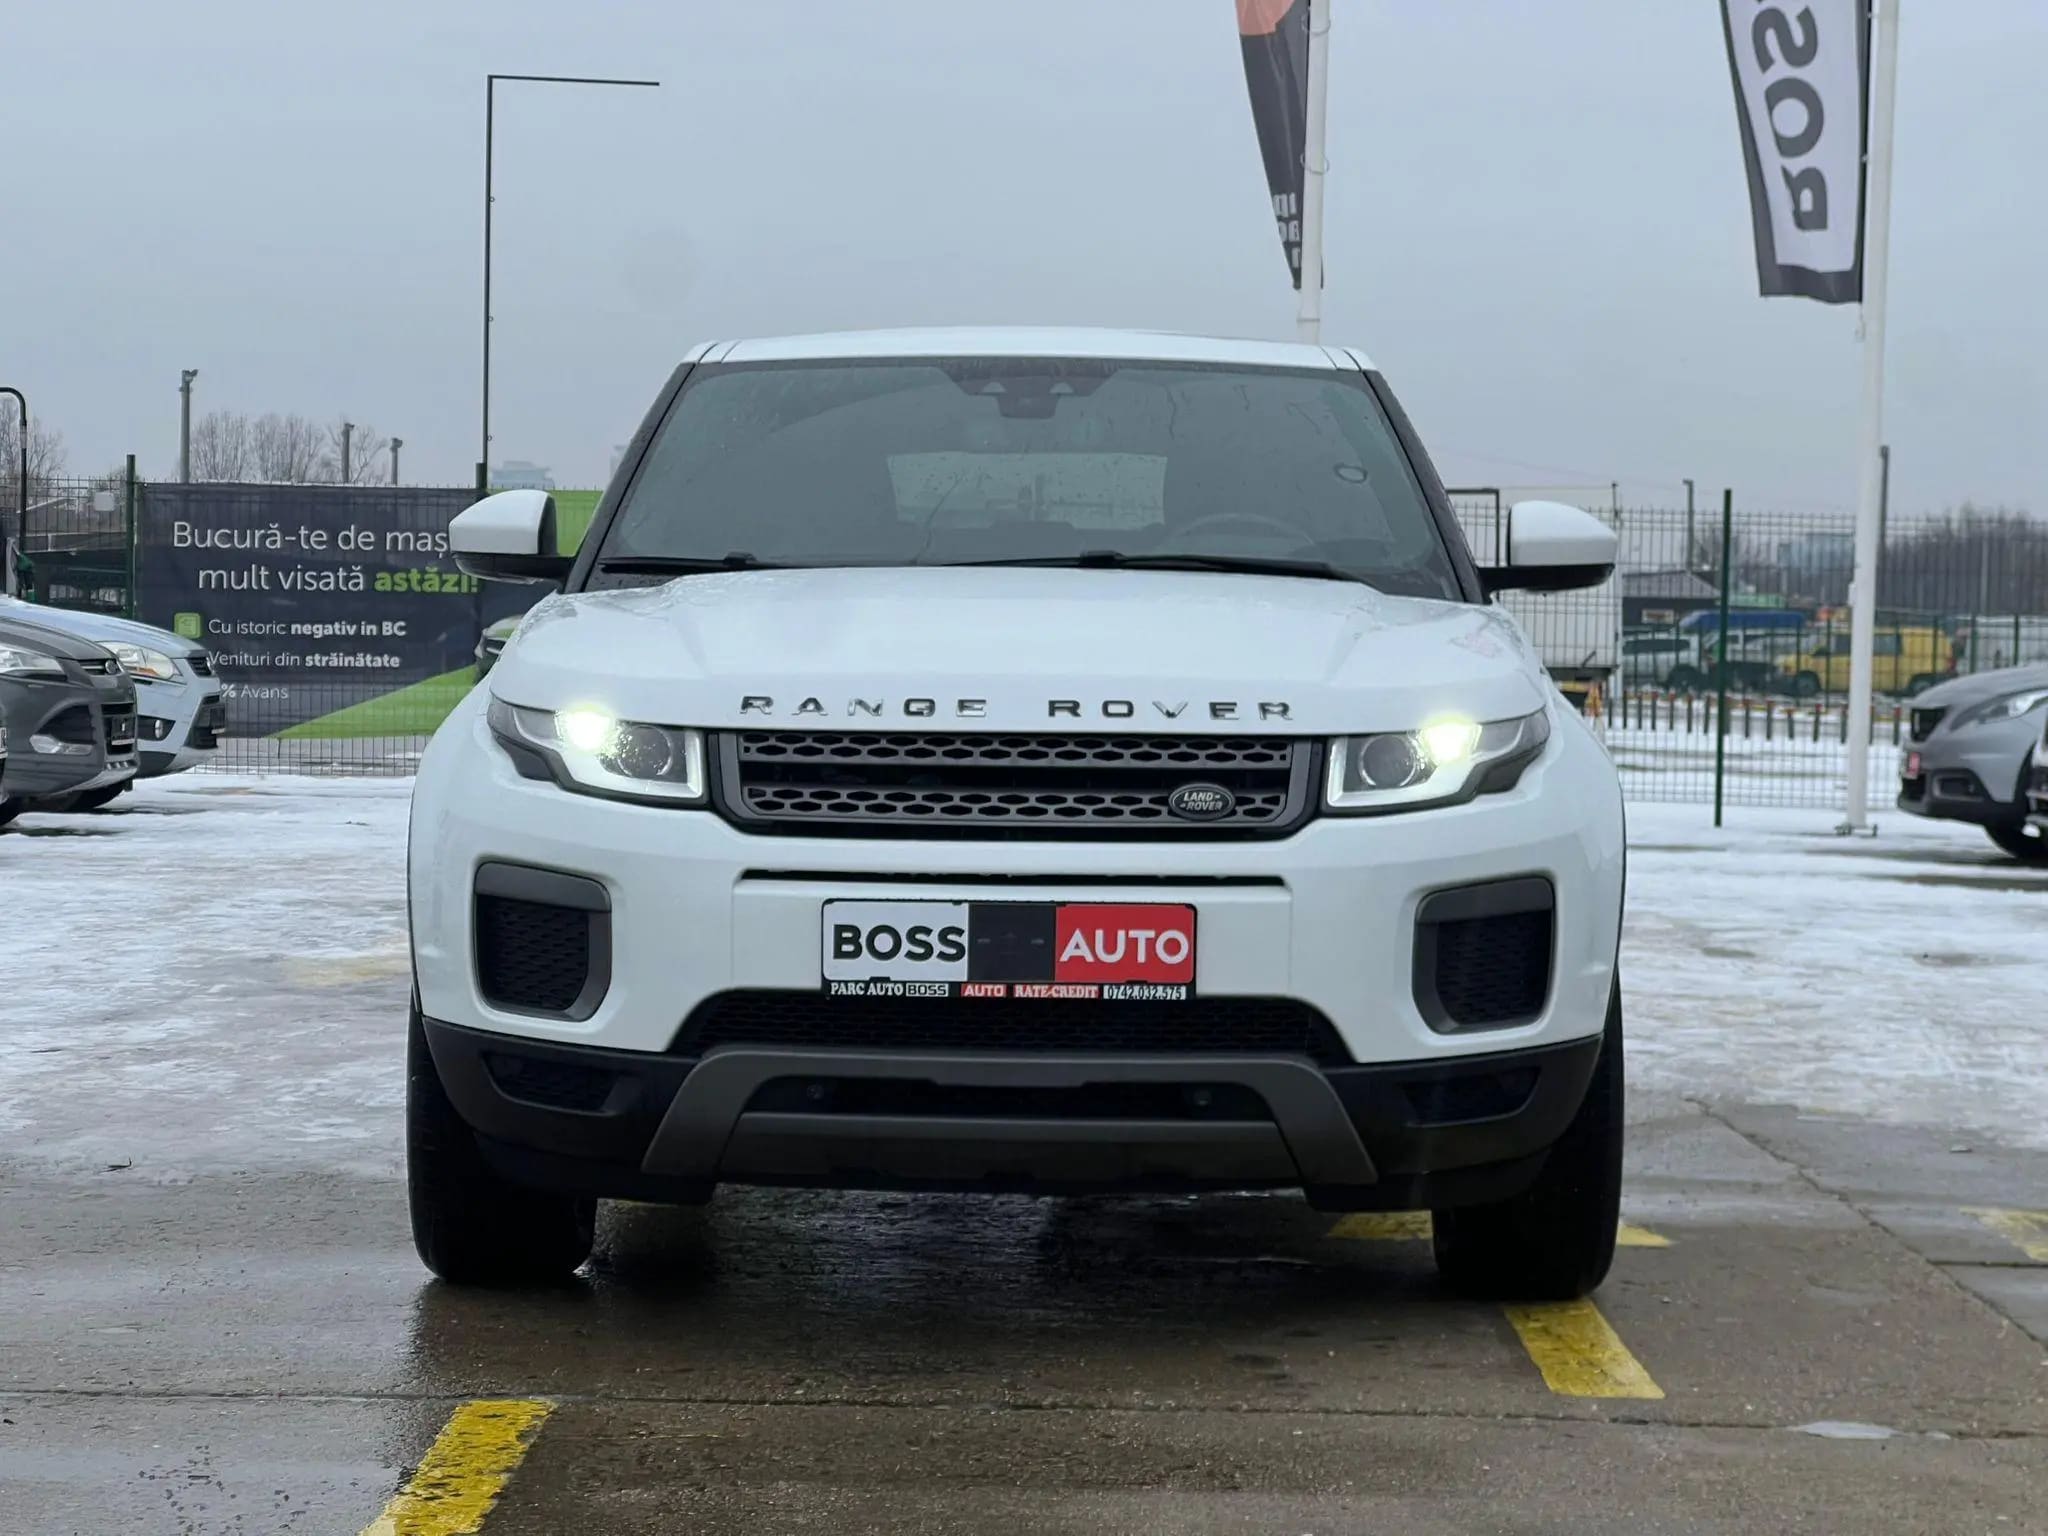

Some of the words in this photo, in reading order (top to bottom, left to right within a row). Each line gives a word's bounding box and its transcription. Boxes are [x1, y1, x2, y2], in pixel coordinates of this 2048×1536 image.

[173, 520, 328, 550] Bucură-te
[337, 524, 375, 551] de
[385, 529, 448, 559] maș
[198, 564, 269, 590] mult
[278, 564, 365, 592] visată
[208, 619, 231, 634] Cu
[236, 618, 286, 635] istoric
[290, 620, 357, 638] negativ
[360, 621, 377, 635] in
[382, 622, 407, 636] BC
[208, 650, 270, 666] Venituri
[274, 652, 300, 667] din
[305, 653, 401, 668] străinătate
[240, 685, 289, 699] Avans
[740, 695, 987, 718] RANGE
[1047, 699, 1294, 721] ROVER
[833, 924, 966, 962] BOSS
[1060, 929, 1189, 964] AUTO
[830, 982, 865, 996] PARC
[867, 983, 903, 996] AUTO
[907, 984, 947, 996] BOSS
[964, 984, 1004, 997] AUTO
